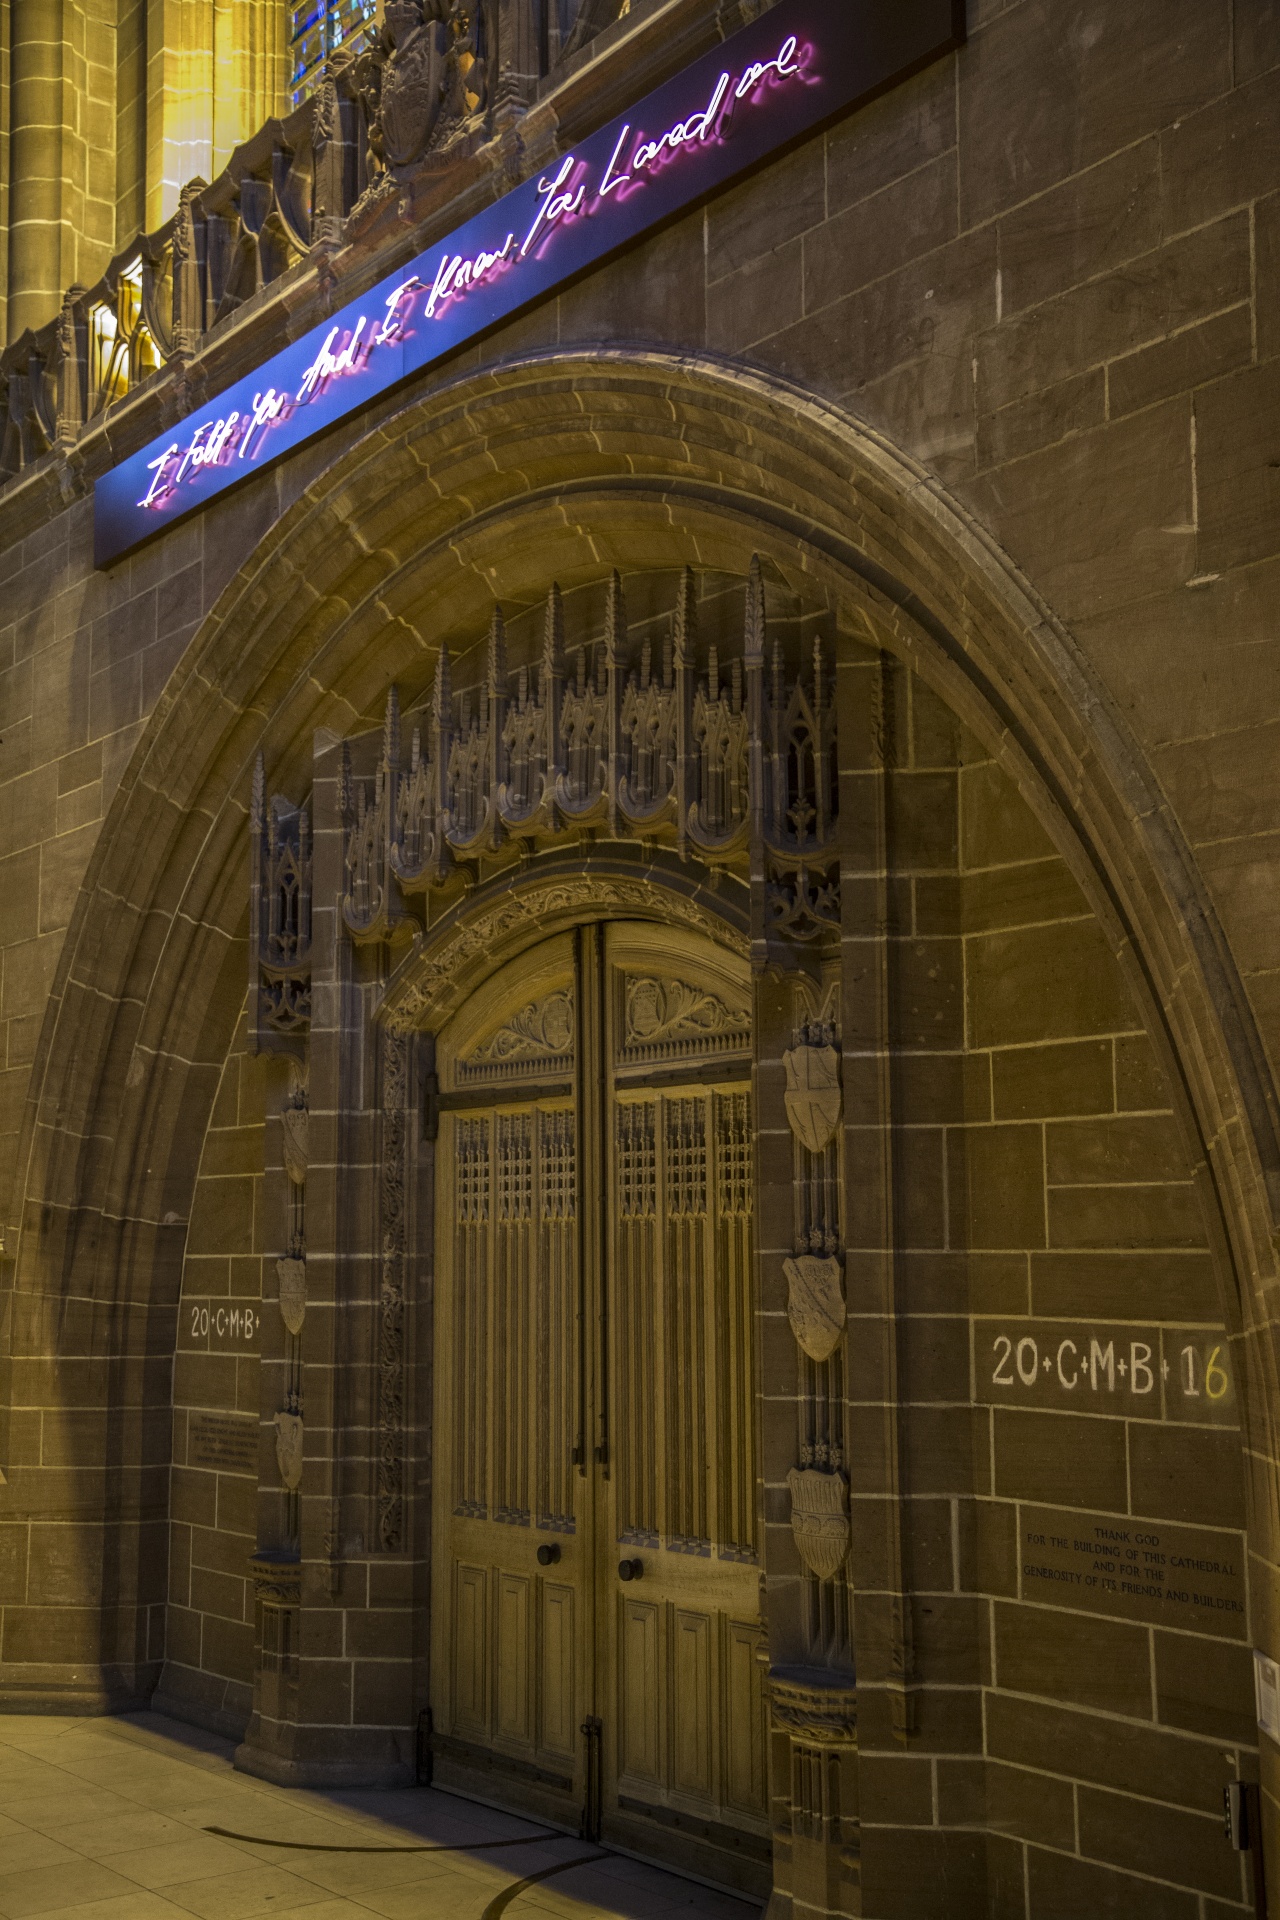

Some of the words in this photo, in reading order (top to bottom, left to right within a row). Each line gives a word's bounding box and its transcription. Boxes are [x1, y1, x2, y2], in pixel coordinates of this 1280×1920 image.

[240, 388, 284, 458] You
[297, 316, 367, 402] And
[376, 275, 420, 346] I
[424, 233, 514, 318] Know
[521, 156, 585, 256] You
[599, 72, 729, 195] Loved
[735, 35, 798, 98] me
[1027, 1533, 1046, 1546] FOR
[1050, 1536, 1069, 1549] THE
[1073, 1540, 1121, 1558] BUILDING
[1125, 1548, 1139, 1561] OF
[1142, 1551, 1166, 1565] THIS
[1170, 1556, 1237, 1577] CATHEDRAL
[1094, 1527, 1130, 1543] THANK
[1135, 1533, 1160, 1547] GOD
[1023, 1565, 1083, 1584] GENEROSITY
[1085, 1575, 1098, 1586] OF
[1101, 1578, 1117, 1591] ITS
[1121, 1582, 1163, 1598] FRIENDS
[1165, 1590, 1189, 1603] AND
[1193, 1594, 1245, 1612] BUILDERS
[1092, 1560, 1116, 1573] AND
[1119, 1563, 1140, 1577] FOR
[1144, 1567, 1165, 1581] THE
